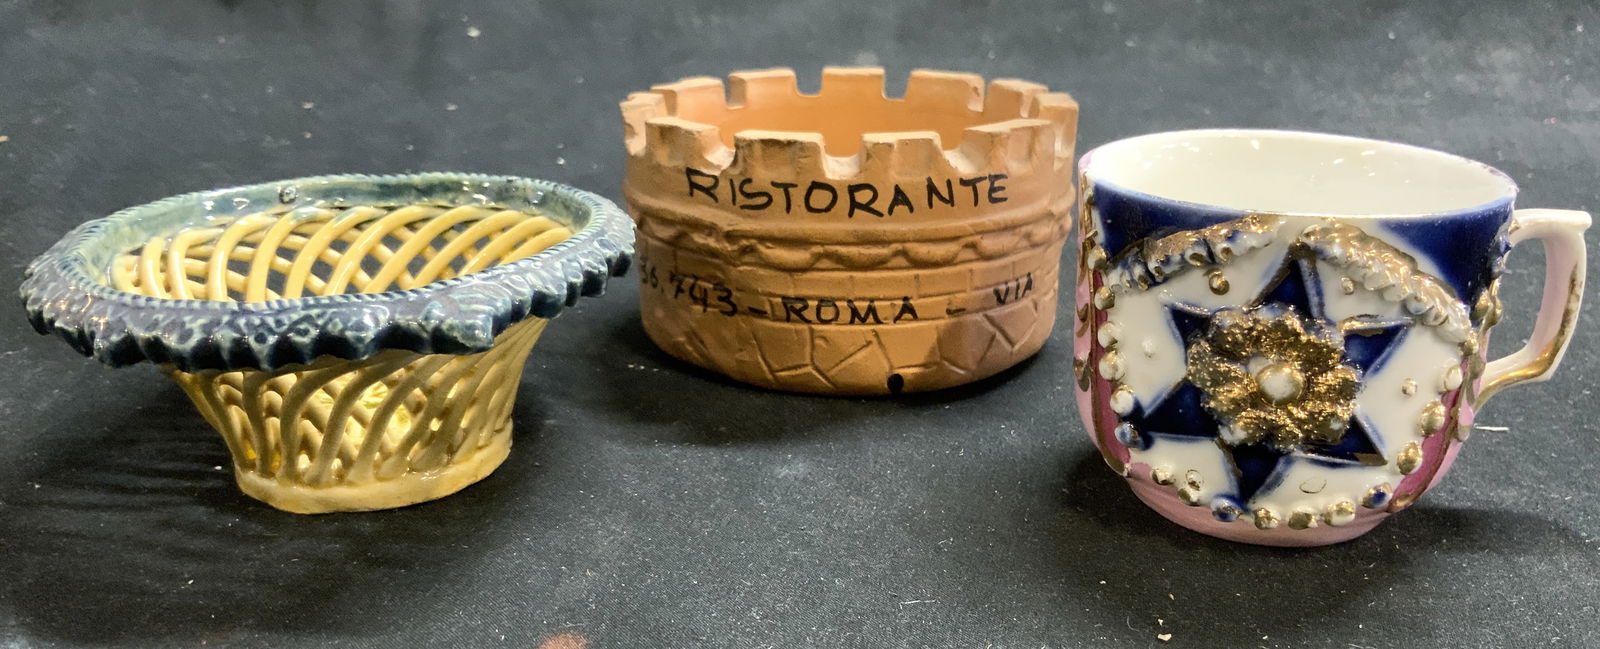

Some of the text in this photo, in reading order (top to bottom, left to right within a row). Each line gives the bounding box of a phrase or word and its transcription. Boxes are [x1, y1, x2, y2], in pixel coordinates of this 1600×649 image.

[685, 168, 1009, 218] RISTORANTE
[781, 297, 920, 325] ROMA
[992, 271, 1033, 305] VIA
